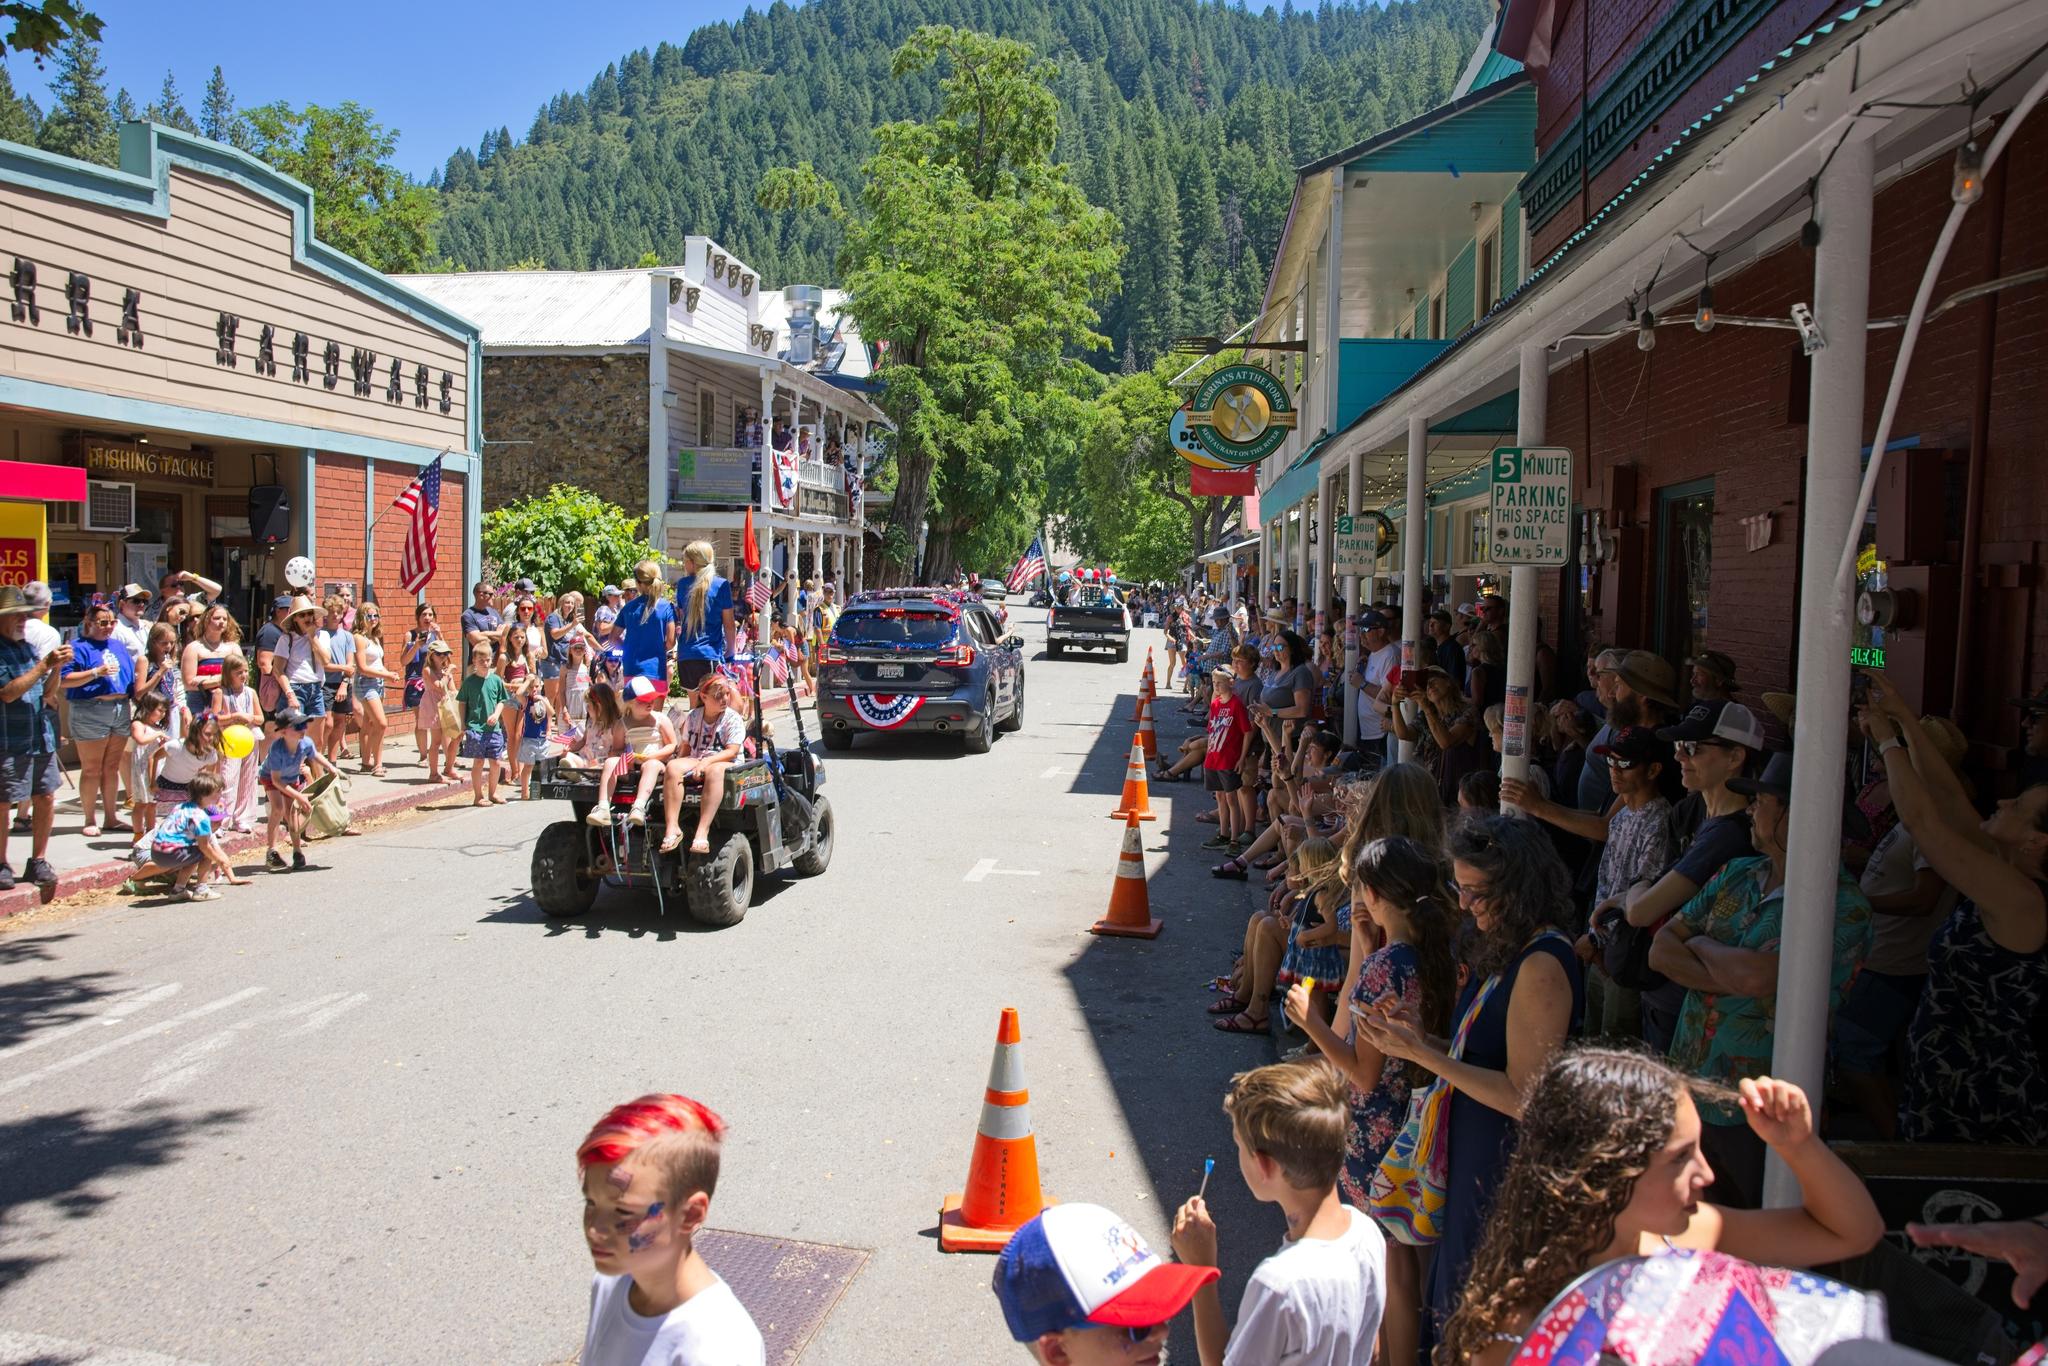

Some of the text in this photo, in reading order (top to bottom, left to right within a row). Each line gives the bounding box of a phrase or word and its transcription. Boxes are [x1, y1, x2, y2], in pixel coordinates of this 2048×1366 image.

[216, 311, 453, 415] HARDWARE
[1200, 371, 1285, 410] SABRINA'S AT THE FORKS
[1201, 427, 1238, 456] RESTAURANT
[1250, 446, 1264, 456] THE
[1264, 430, 1280, 449] RIVER
[91, 446, 214, 479] FISHING TACKLE
[1499, 453, 1568, 479] 5 MINUTE
[1496, 485, 1566, 507] PARKING
[1341, 519, 1375, 533] 2 HOUR
[1496, 508, 1565, 524] THIS SPACE
[1513, 525, 1545, 540] ONLY
[1340, 539, 1375, 551] PARKING
[0, 550, 28, 567] LS
[688, 730, 724, 751] USA
